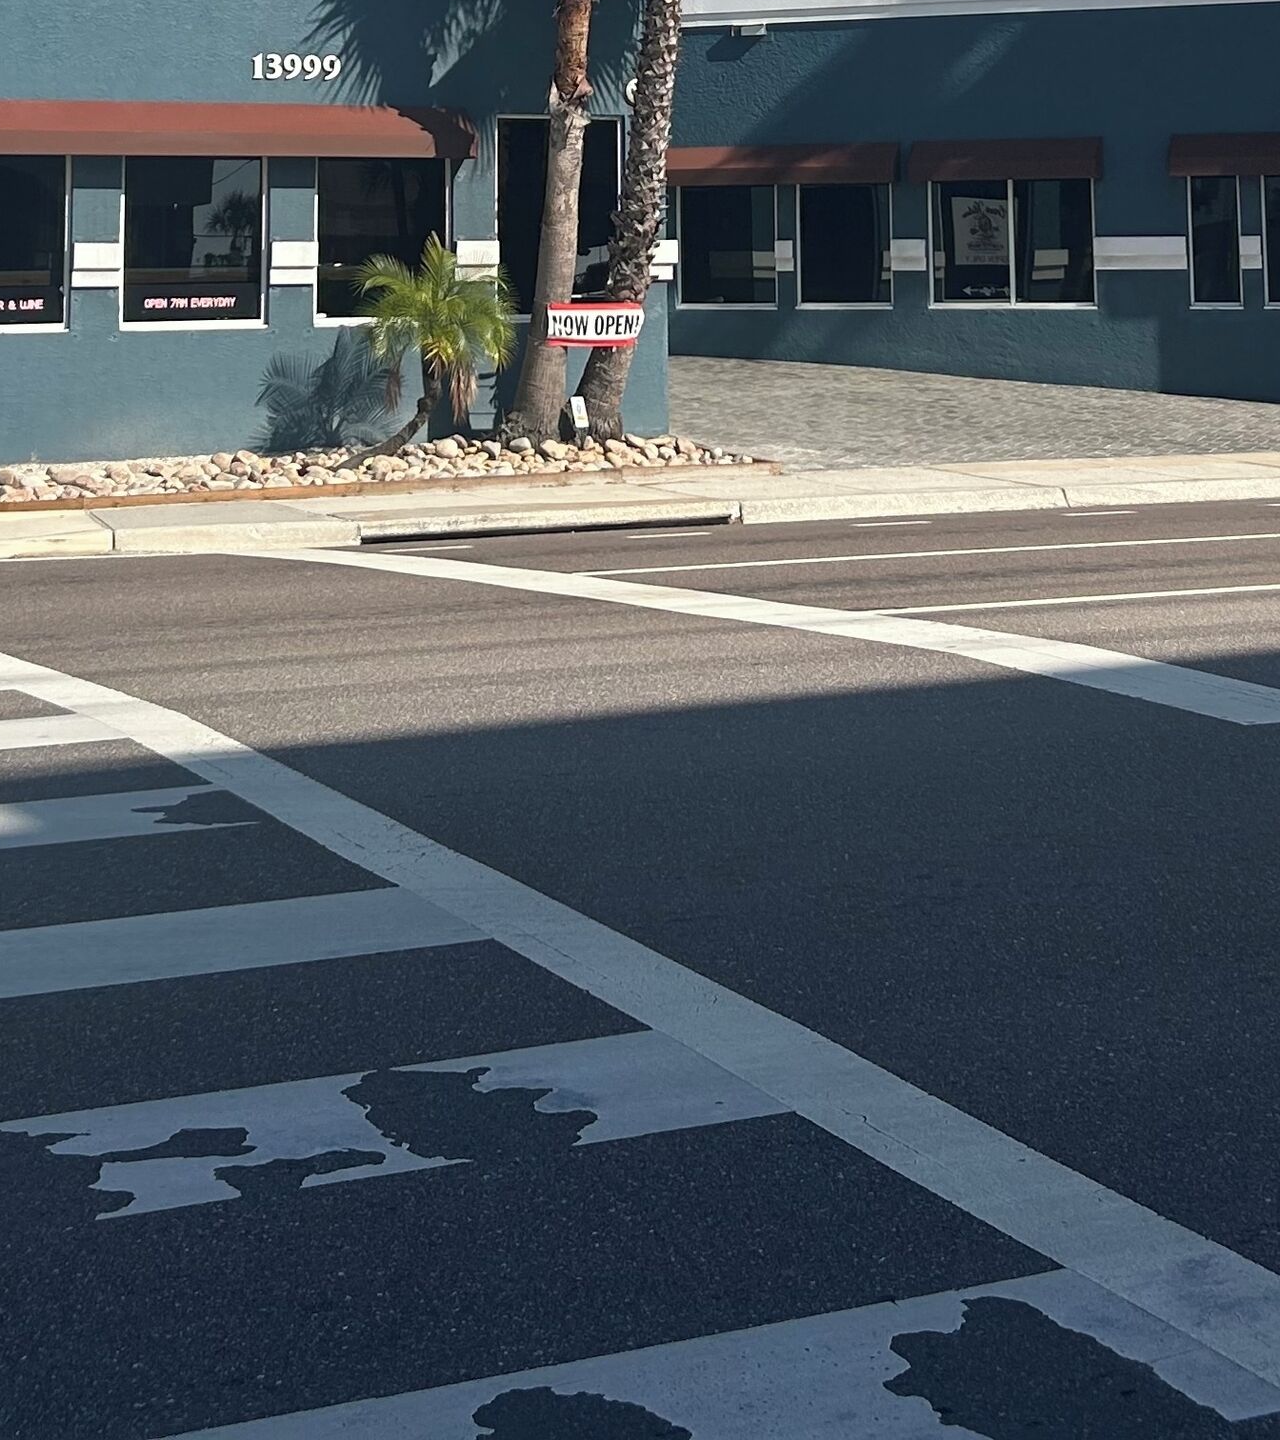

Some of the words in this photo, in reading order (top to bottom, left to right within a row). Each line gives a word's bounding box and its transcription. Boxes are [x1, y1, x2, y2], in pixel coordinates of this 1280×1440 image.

[251, 52, 341, 81] 13999
[8, 300, 17, 310] &
[20, 299, 44, 310] WINE
[144, 298, 168, 308] OPEN
[170, 297, 188, 308] 7AM
[190, 296, 236, 308] EVERYDAY
[552, 314, 589, 336] NOW
[594, 314, 640, 336] OPEN!
